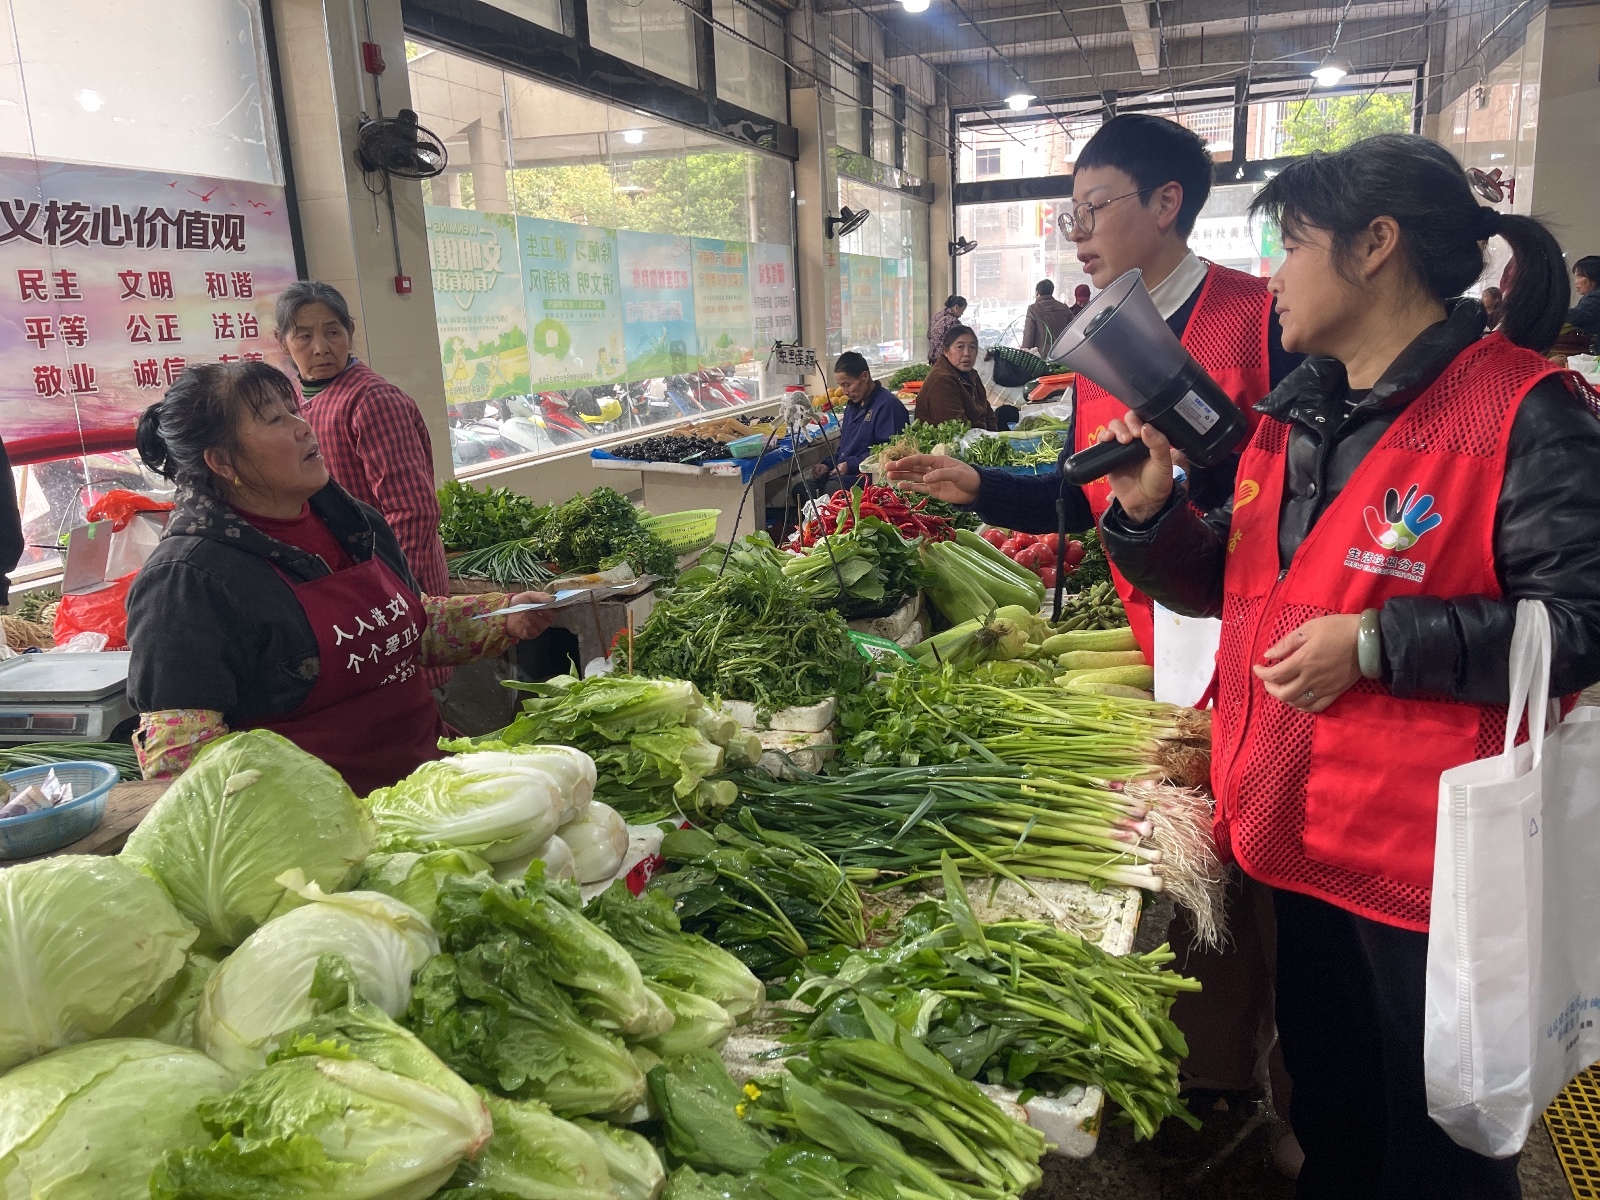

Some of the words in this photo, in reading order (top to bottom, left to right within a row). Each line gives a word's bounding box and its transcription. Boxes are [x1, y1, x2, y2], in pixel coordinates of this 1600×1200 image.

[0, 199, 247, 252] 义核心价值观
[17, 268, 82, 302] 民主
[117, 269, 174, 300] 文明
[205, 271, 254, 299] 和谐
[24, 315, 88, 349] 平等
[126, 313, 182, 343] 公正
[211, 312, 259, 340] 法治
[33, 363, 99, 397] 敬业
[132, 357, 187, 388] 诚信
